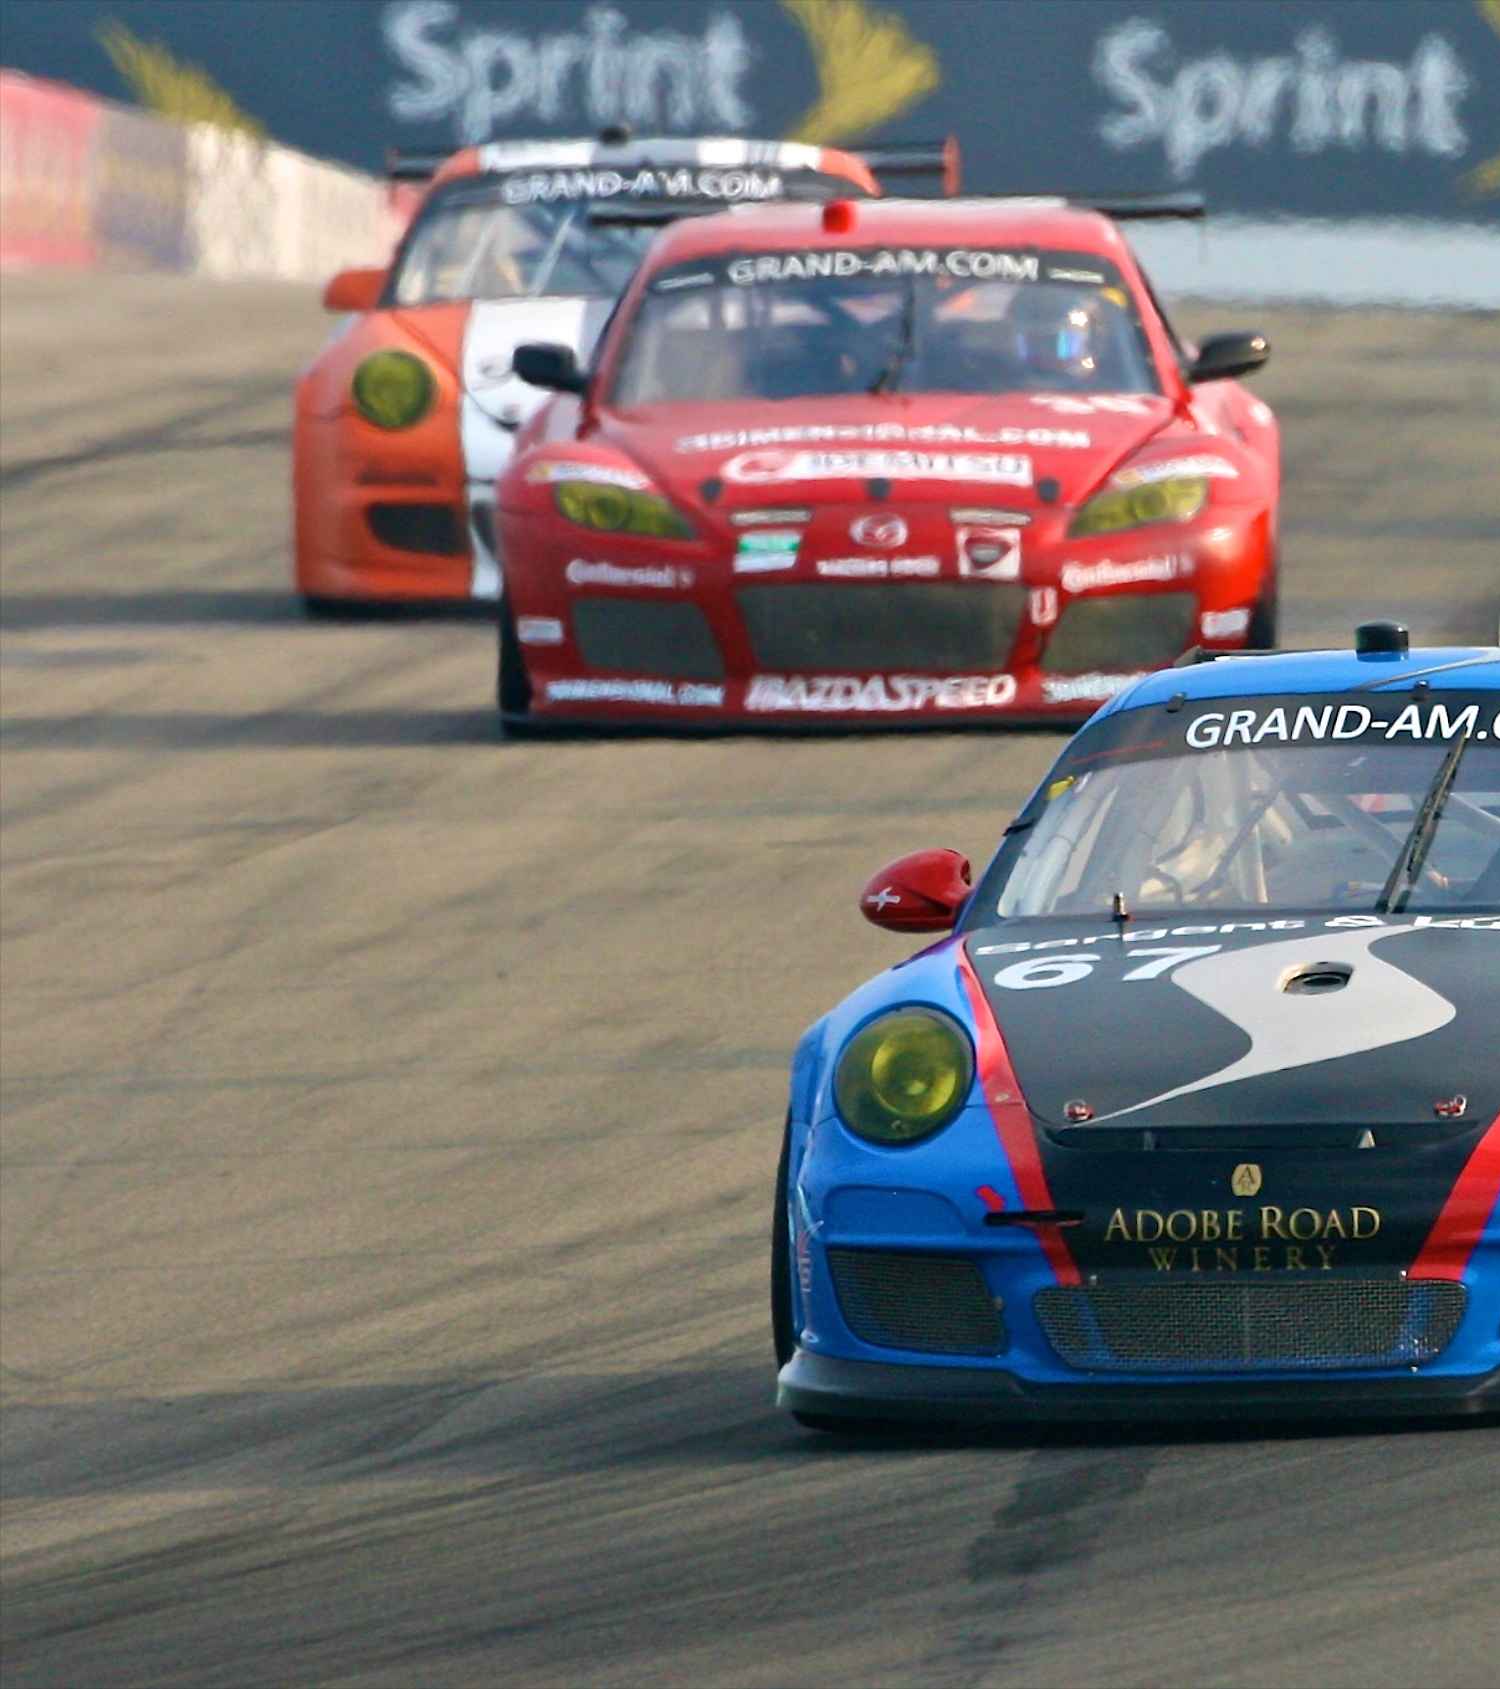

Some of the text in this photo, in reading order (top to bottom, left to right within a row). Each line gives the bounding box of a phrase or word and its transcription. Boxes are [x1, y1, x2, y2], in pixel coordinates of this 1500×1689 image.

[383, 0, 752, 143] Sprint
[1095, 18, 1470, 180] Sprint
[728, 250, 1040, 284] GRAND-AM.COM
[744, 674, 1017, 711] MAZDASPEED
[1324, 914, 1388, 928] &
[993, 944, 1223, 990] 67
[1103, 1205, 1382, 1242] ADOBE ROAD
[1147, 1246, 1337, 1272] WINERY
